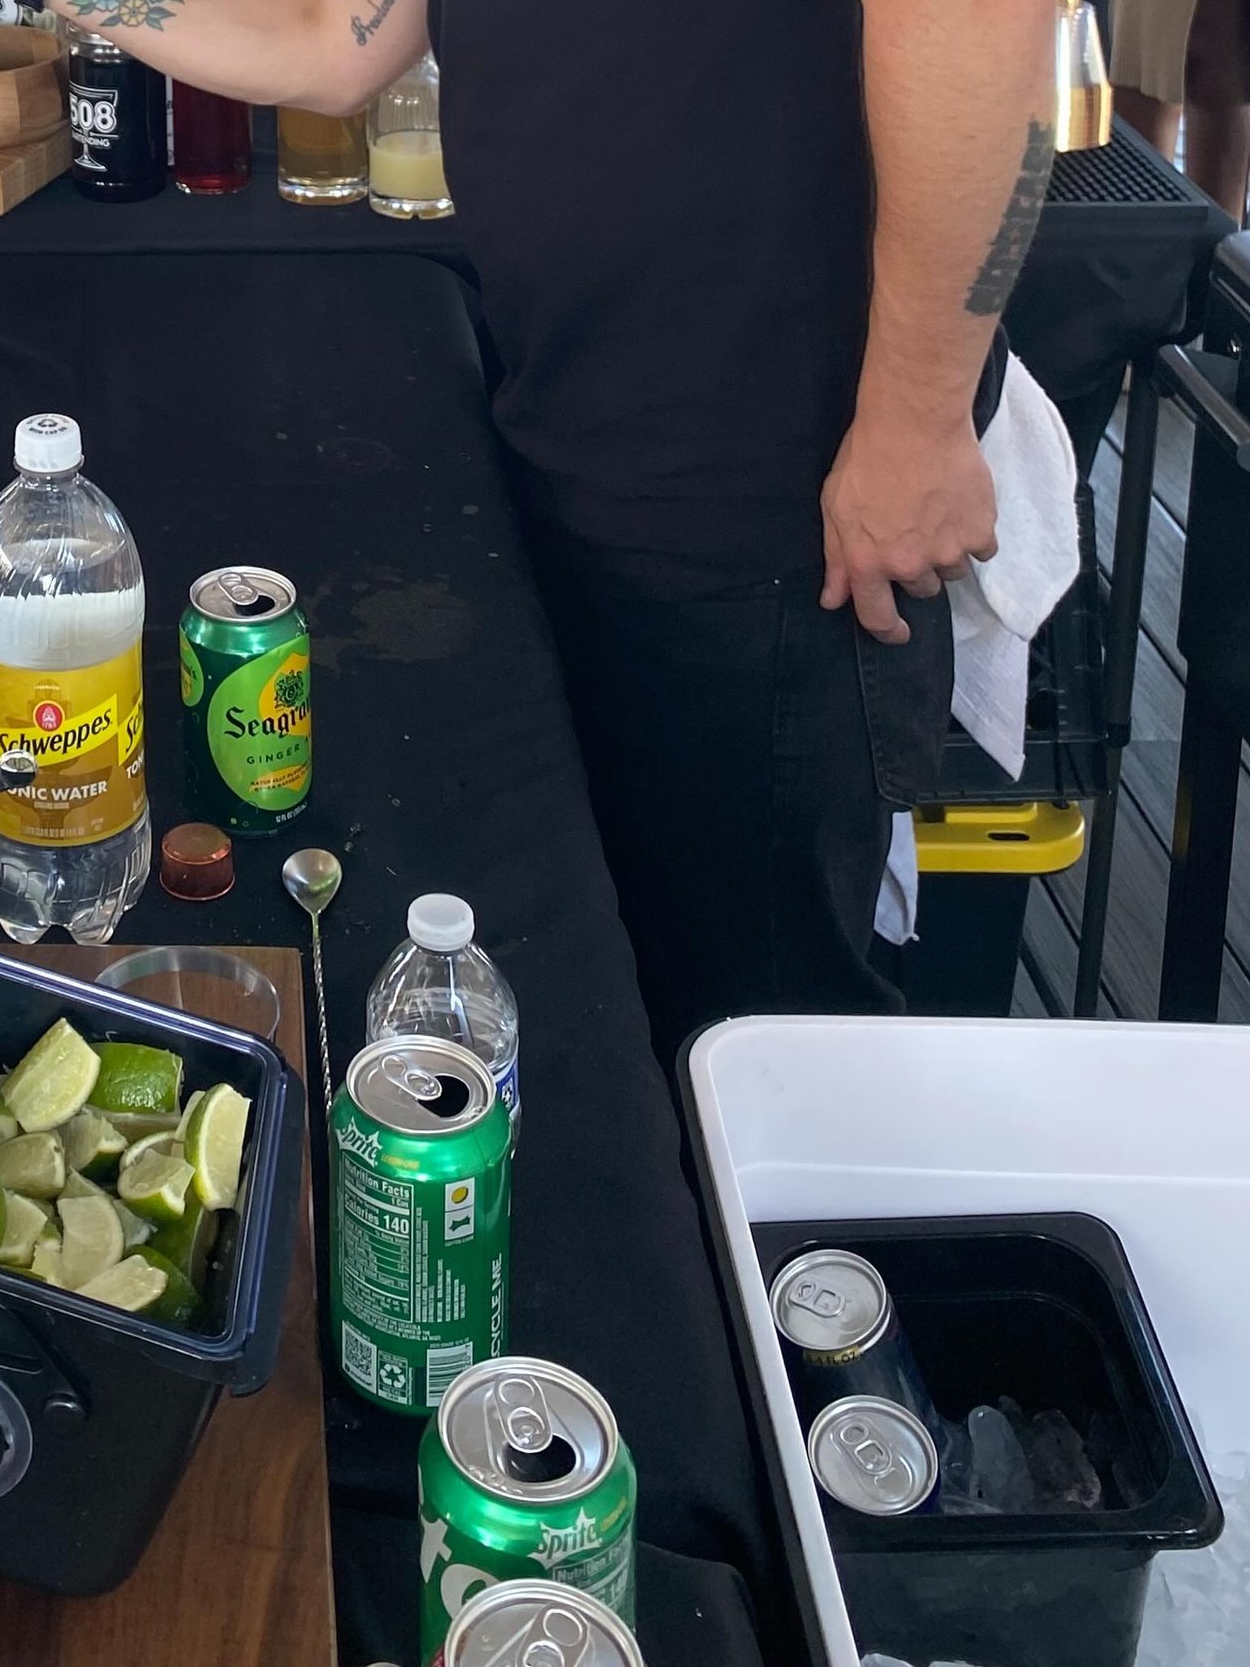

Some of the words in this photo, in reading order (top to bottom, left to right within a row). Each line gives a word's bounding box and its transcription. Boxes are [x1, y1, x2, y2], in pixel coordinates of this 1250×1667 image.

[69, 92, 117, 134] 508
[224, 695, 310, 739] Seagra
[246, 743, 301, 766] GINGER
[6, 785, 48, 801] NIC
[51, 780, 108, 802] WATER
[344, 1160, 380, 1189] Nutrition
[381, 1181, 411, 1198] Facts
[344, 1192, 380, 1226] Calories
[383, 1214, 410, 1235] 140
[491, 1288, 502, 1358] CYCLE
[535, 1521, 598, 1561] Sprite
